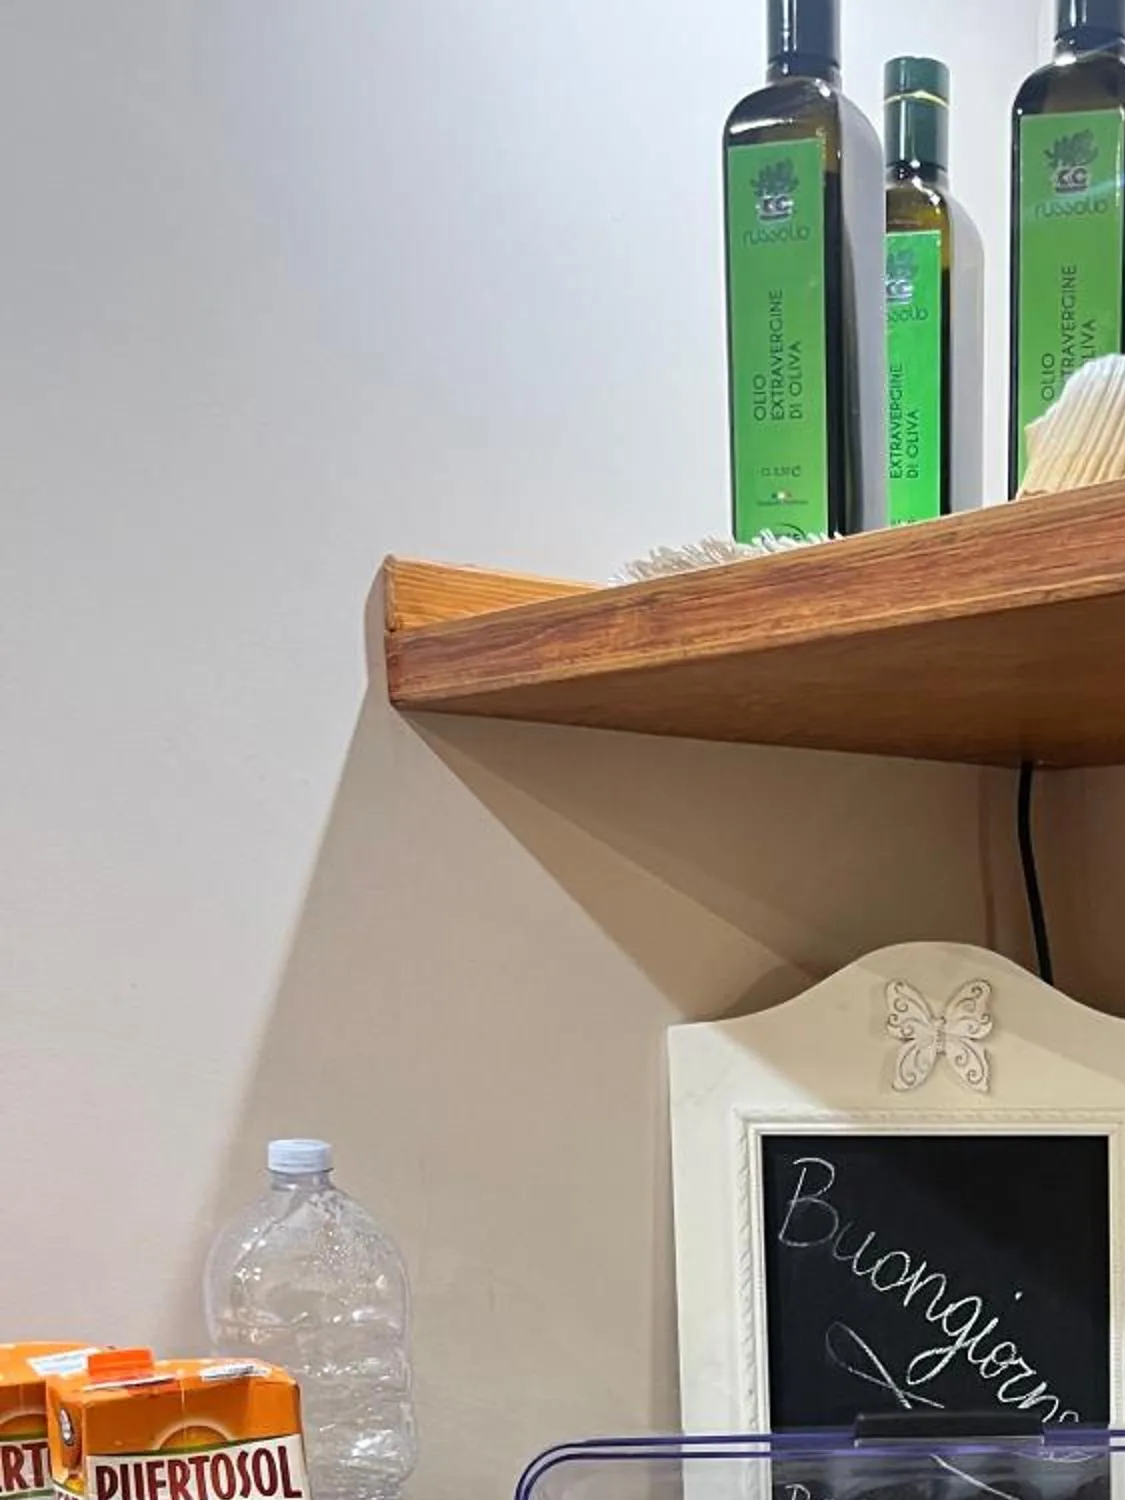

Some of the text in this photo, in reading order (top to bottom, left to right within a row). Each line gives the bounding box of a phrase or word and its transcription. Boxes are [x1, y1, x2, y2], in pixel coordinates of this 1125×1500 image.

[769, 288, 784, 421] EXTRAVERGINE
[1061, 264, 1077, 378] TRAVERGINE
[1080, 318, 1097, 360] LIVA
[752, 374, 767, 421] OLIO
[787, 340, 803, 420] DI OLIVA
[1041, 353, 1055, 402] OLIO
[889, 363, 903, 480] EXTRAVERGINE
[905, 409, 919, 480] DI OLIVA
[0, 1440, 50, 1494] RT
